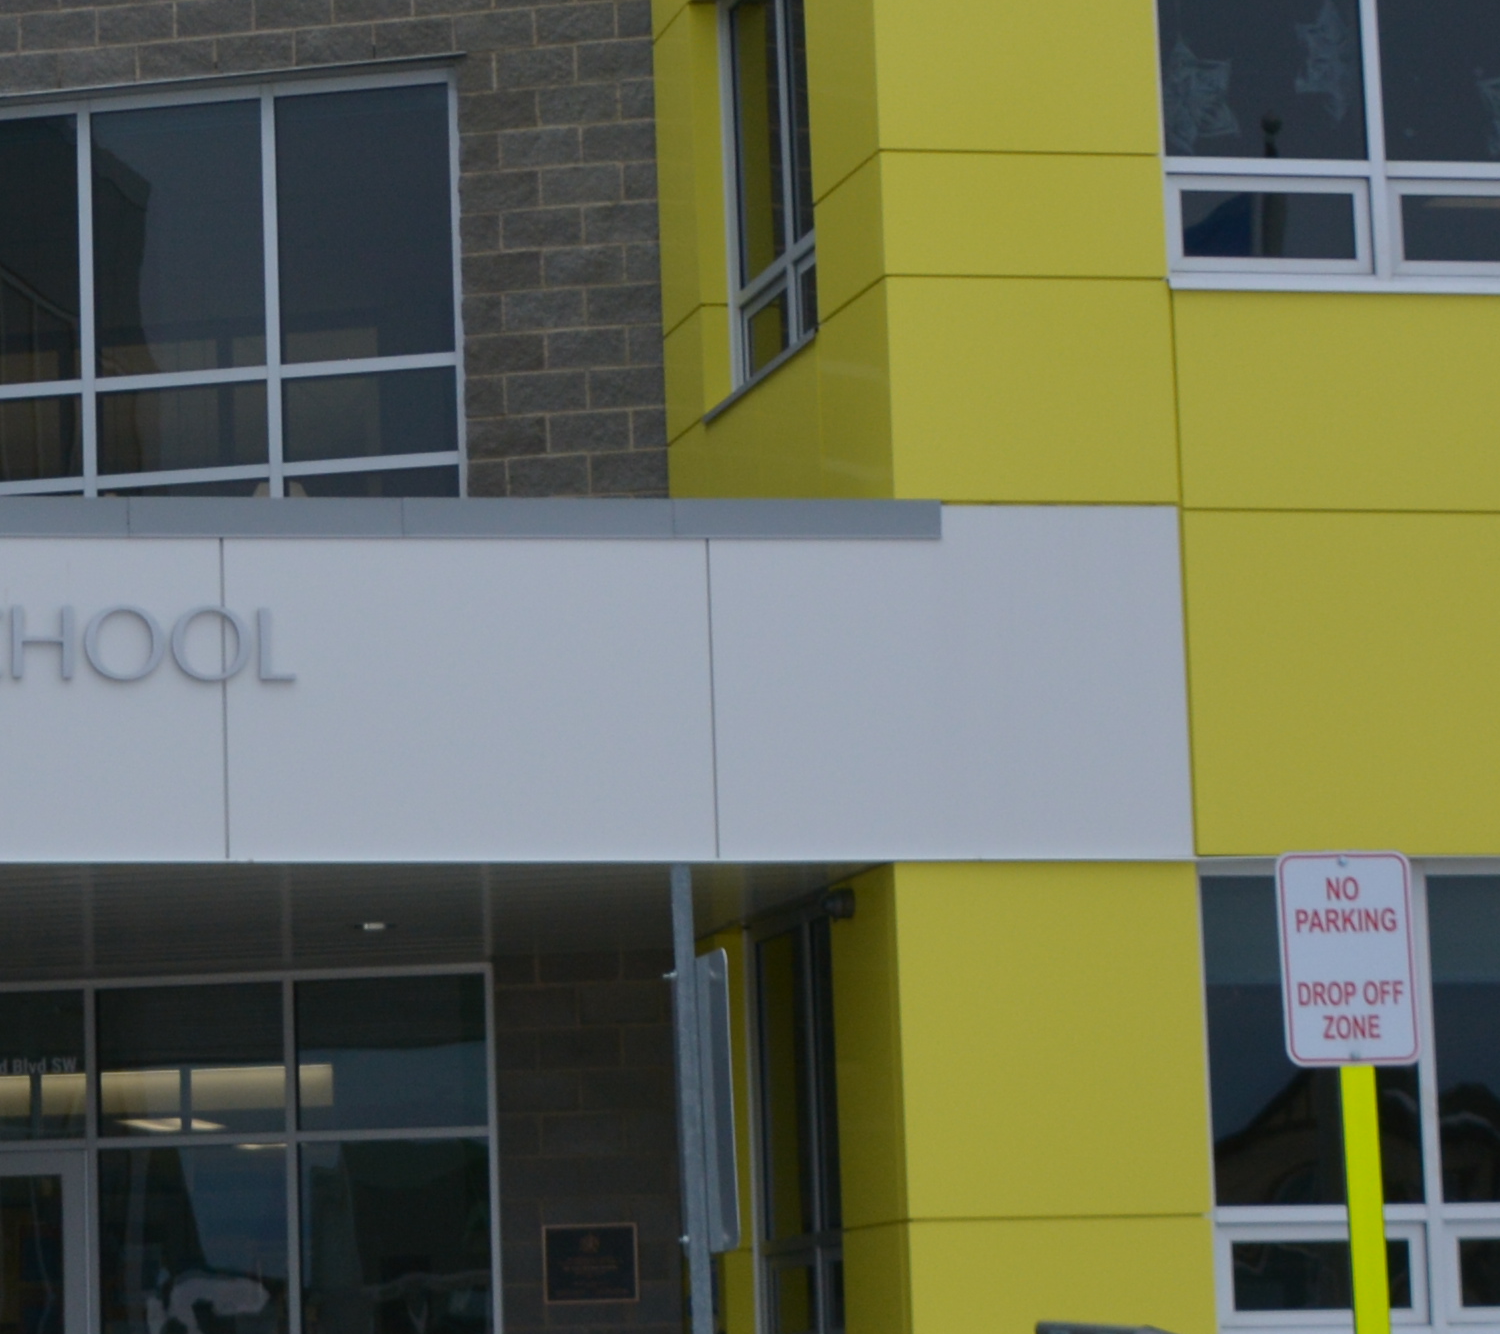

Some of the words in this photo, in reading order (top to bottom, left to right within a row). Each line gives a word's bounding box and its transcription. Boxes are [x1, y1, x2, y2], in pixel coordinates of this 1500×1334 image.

[1326, 878, 1359, 900] NO
[1295, 907, 1397, 933] PARKING
[1298, 981, 1355, 1006] DROP
[1363, 981, 1403, 1004] OFF
[1323, 1015, 1380, 1039] ZONE
[12, 1057, 46, 1075] Blvd
[51, 1057, 77, 1073] SW
